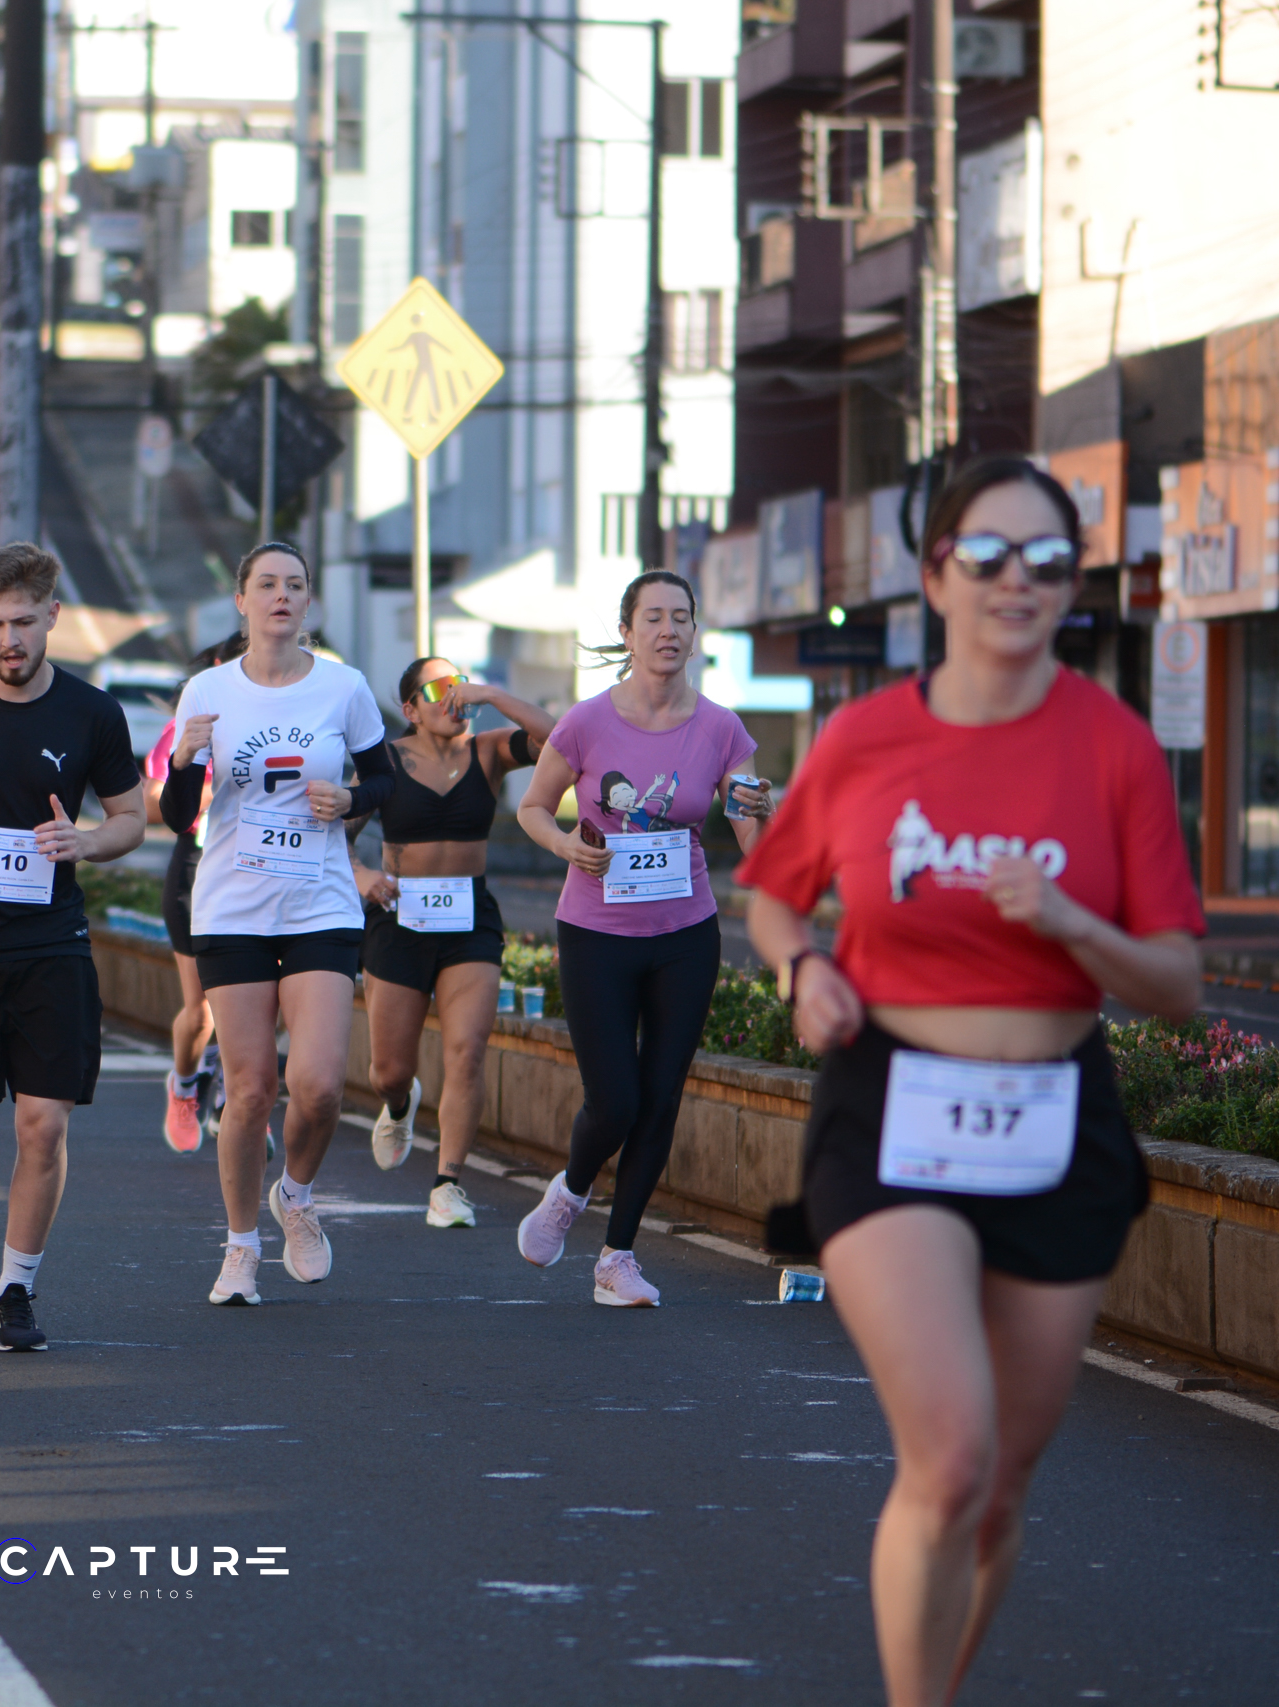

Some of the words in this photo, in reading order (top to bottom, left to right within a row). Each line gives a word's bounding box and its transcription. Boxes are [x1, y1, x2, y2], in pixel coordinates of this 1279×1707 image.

[232, 727, 281, 789] TENNIS
[288, 727, 314, 749] 88
[262, 829, 302, 849] 210
[629, 852, 668, 870] 223
[421, 894, 453, 908] 120
[946, 1102, 1024, 1138] 137
